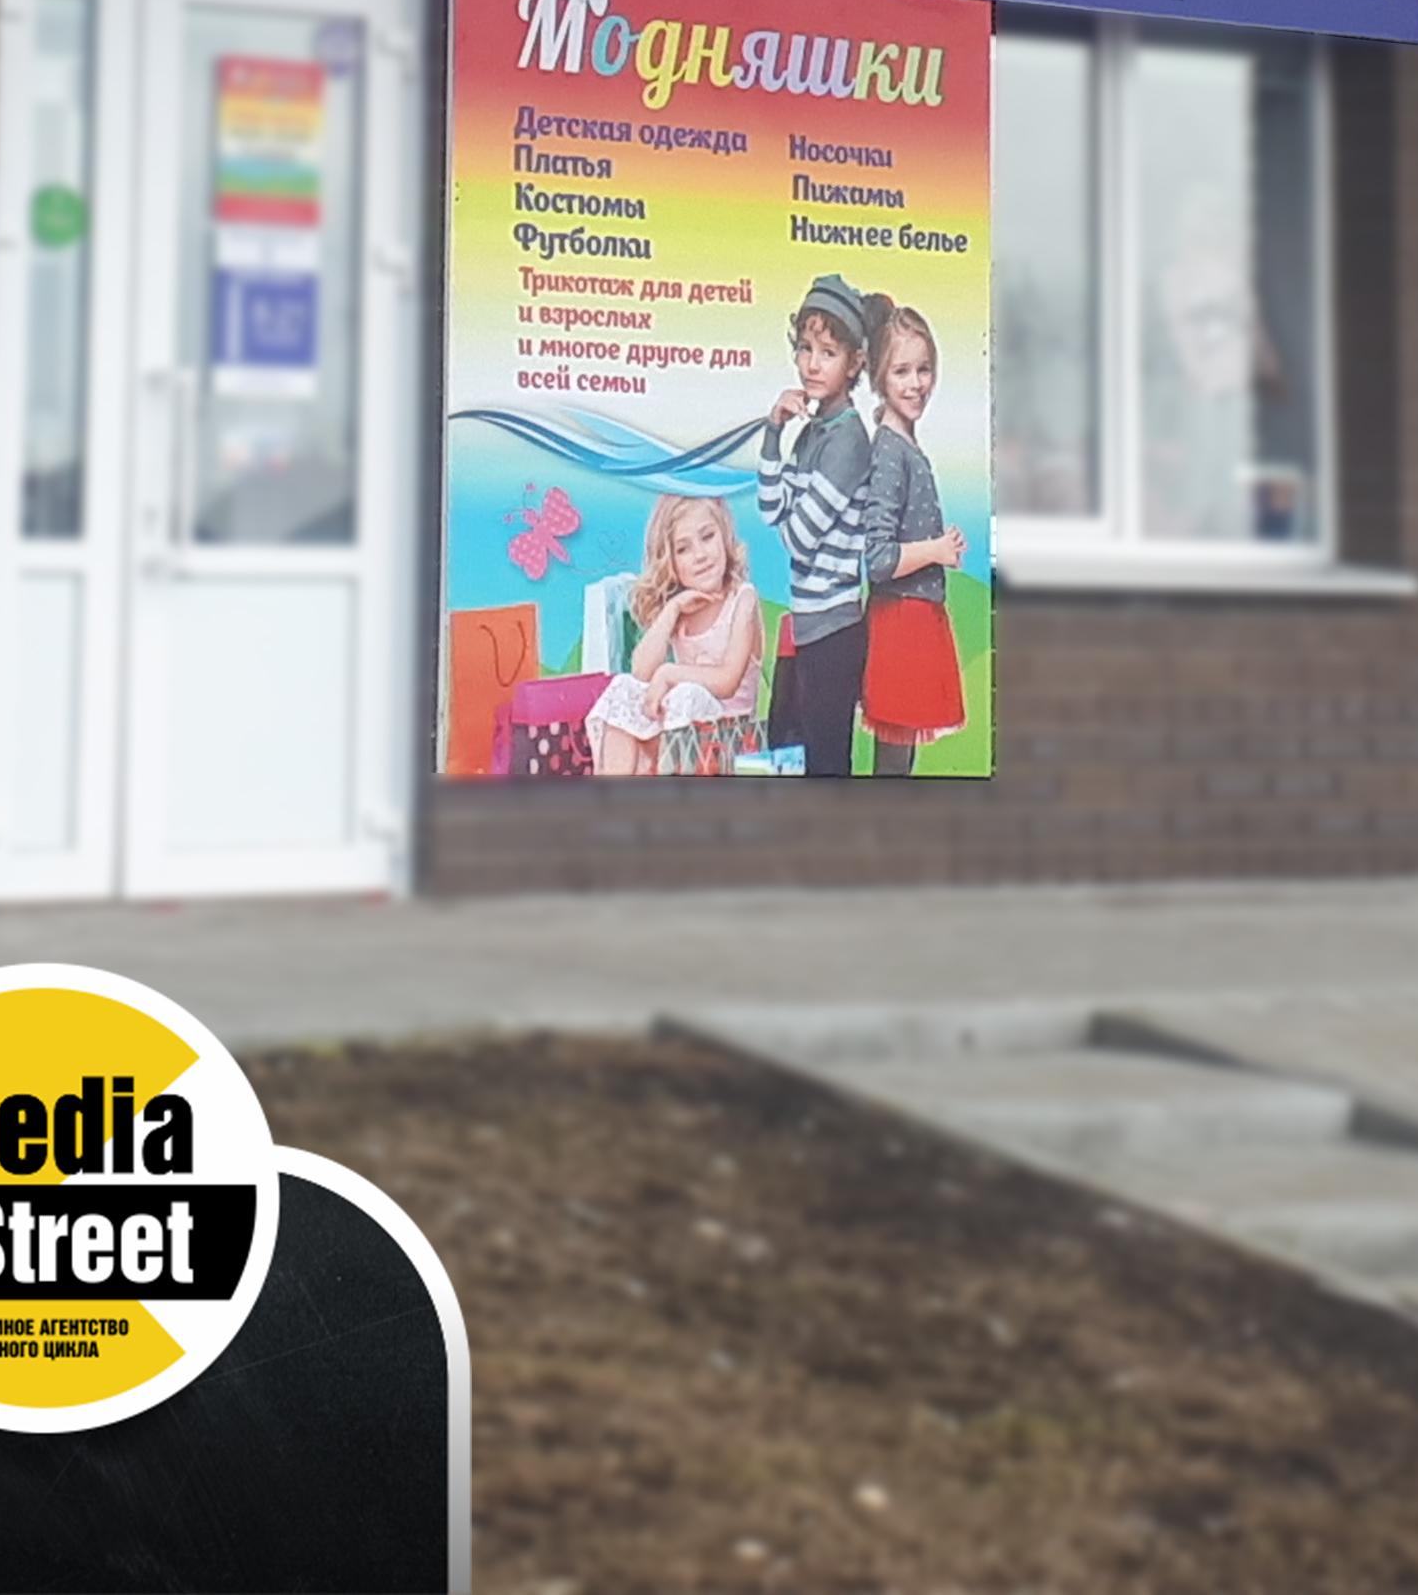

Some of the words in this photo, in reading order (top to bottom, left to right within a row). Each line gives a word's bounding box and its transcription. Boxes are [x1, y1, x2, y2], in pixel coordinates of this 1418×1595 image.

[514, 106, 631, 142] Детская
[639, 123, 747, 155] одежда
[514, 144, 612, 178] Платья
[789, 134, 892, 168] Носочки
[514, 183, 646, 219] Костюмы
[792, 174, 905, 208] Пижамы
[513, 222, 652, 260] Футболки
[790, 214, 893, 246] Нижнее
[899, 223, 968, 253] белье
[518, 266, 634, 297] Трикотаж
[639, 279, 683, 301] для
[688, 279, 752, 304] детей
[518, 305, 533, 323] и
[539, 306, 652, 331] взрослых
[518, 338, 533, 357] и
[539, 338, 620, 360] многое
[626, 342, 704, 368] другое
[710, 347, 752, 369] для
[517, 365, 570, 390] всей
[576, 373, 647, 395] семьи
